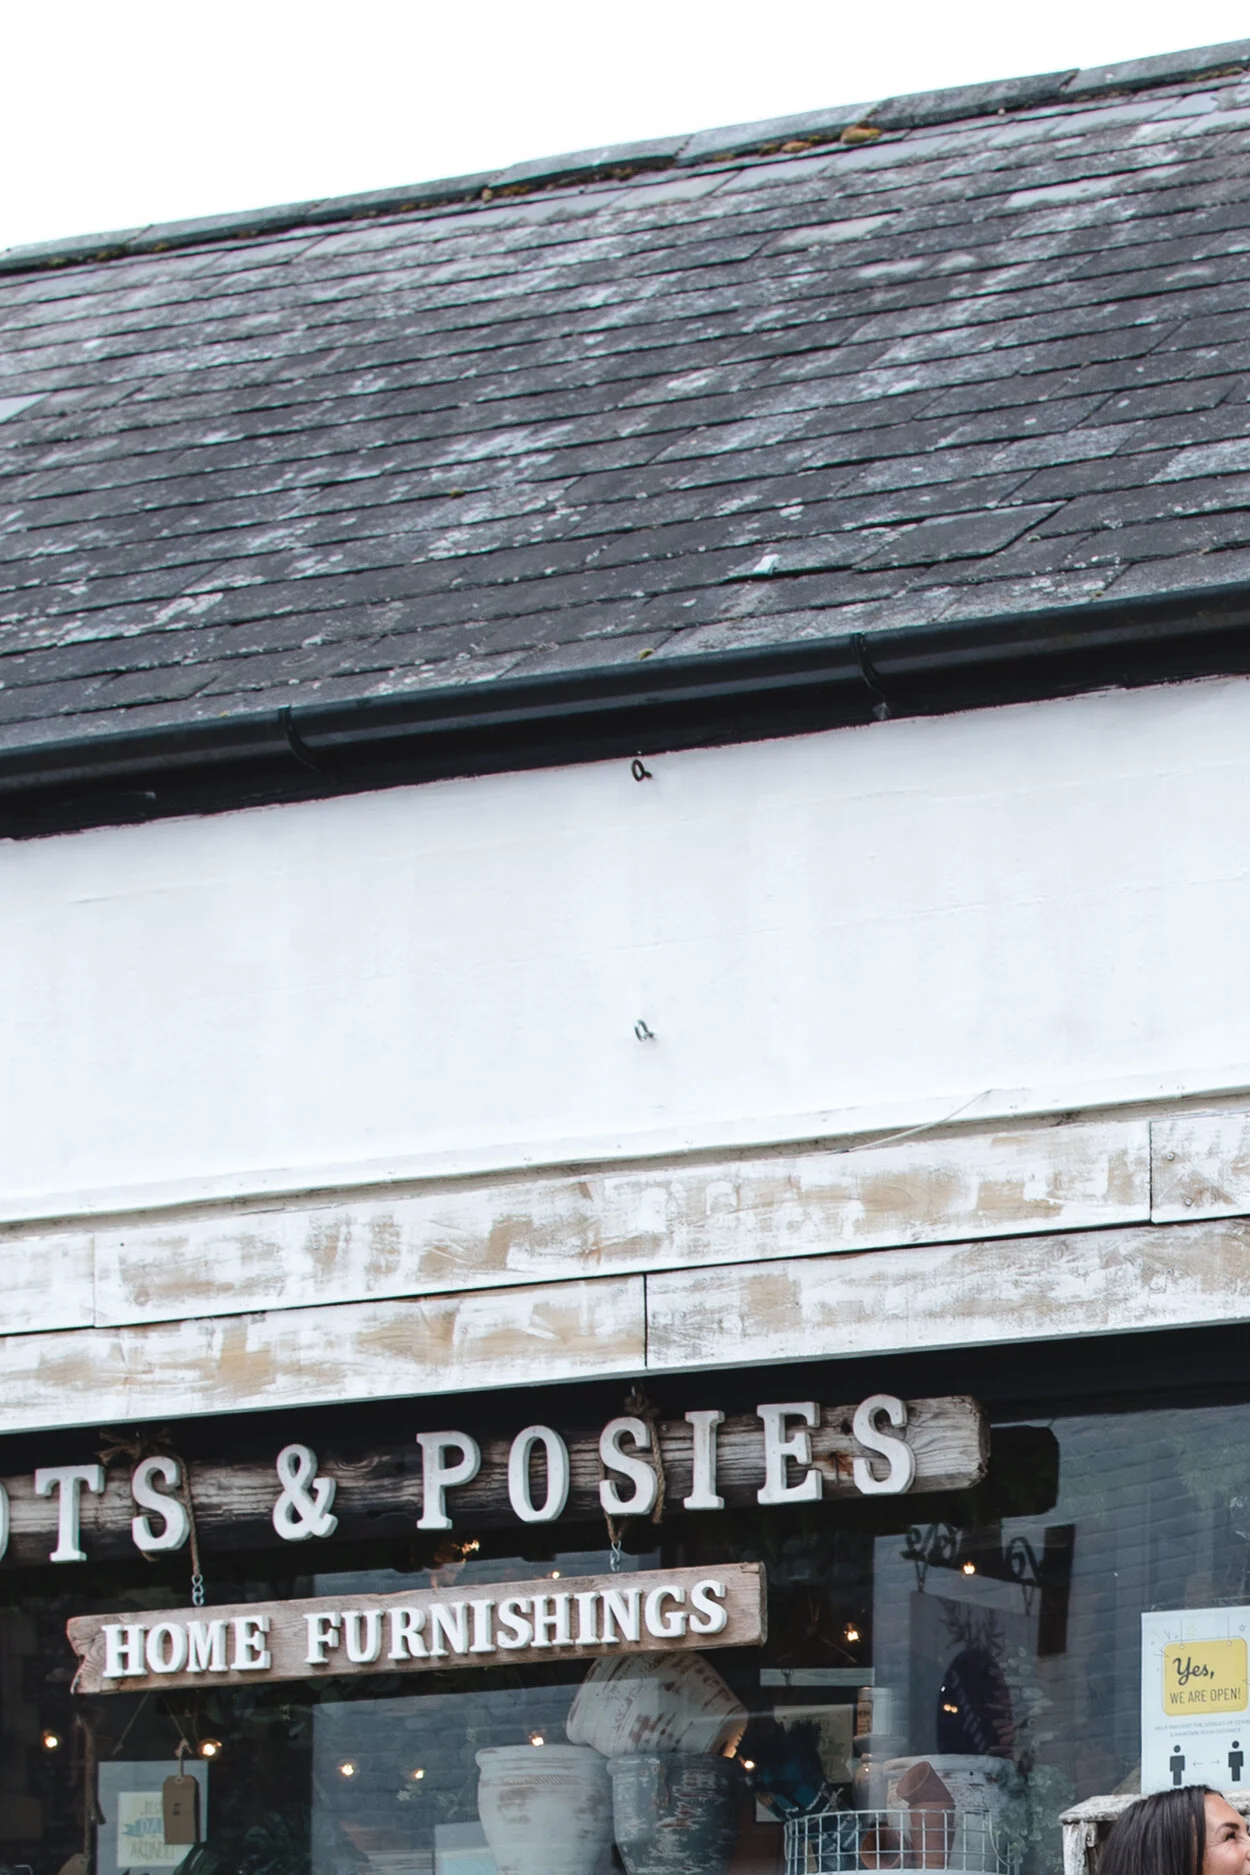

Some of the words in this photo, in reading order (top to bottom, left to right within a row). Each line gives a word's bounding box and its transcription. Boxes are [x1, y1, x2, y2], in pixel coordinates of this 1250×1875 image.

[0, 1455, 191, 1563] TS
[272, 1442, 338, 1542] &
[416, 1393, 918, 1531] POSIES
[101, 1613, 272, 1679] HOME
[304, 1579, 729, 1666] FURNISHINGS
[1170, 1691, 1186, 1705] WE
[1188, 1690, 1207, 1702] ARE
[1210, 1687, 1241, 1702] OPEN!
[1173, 1656, 1215, 1686] Yes,
